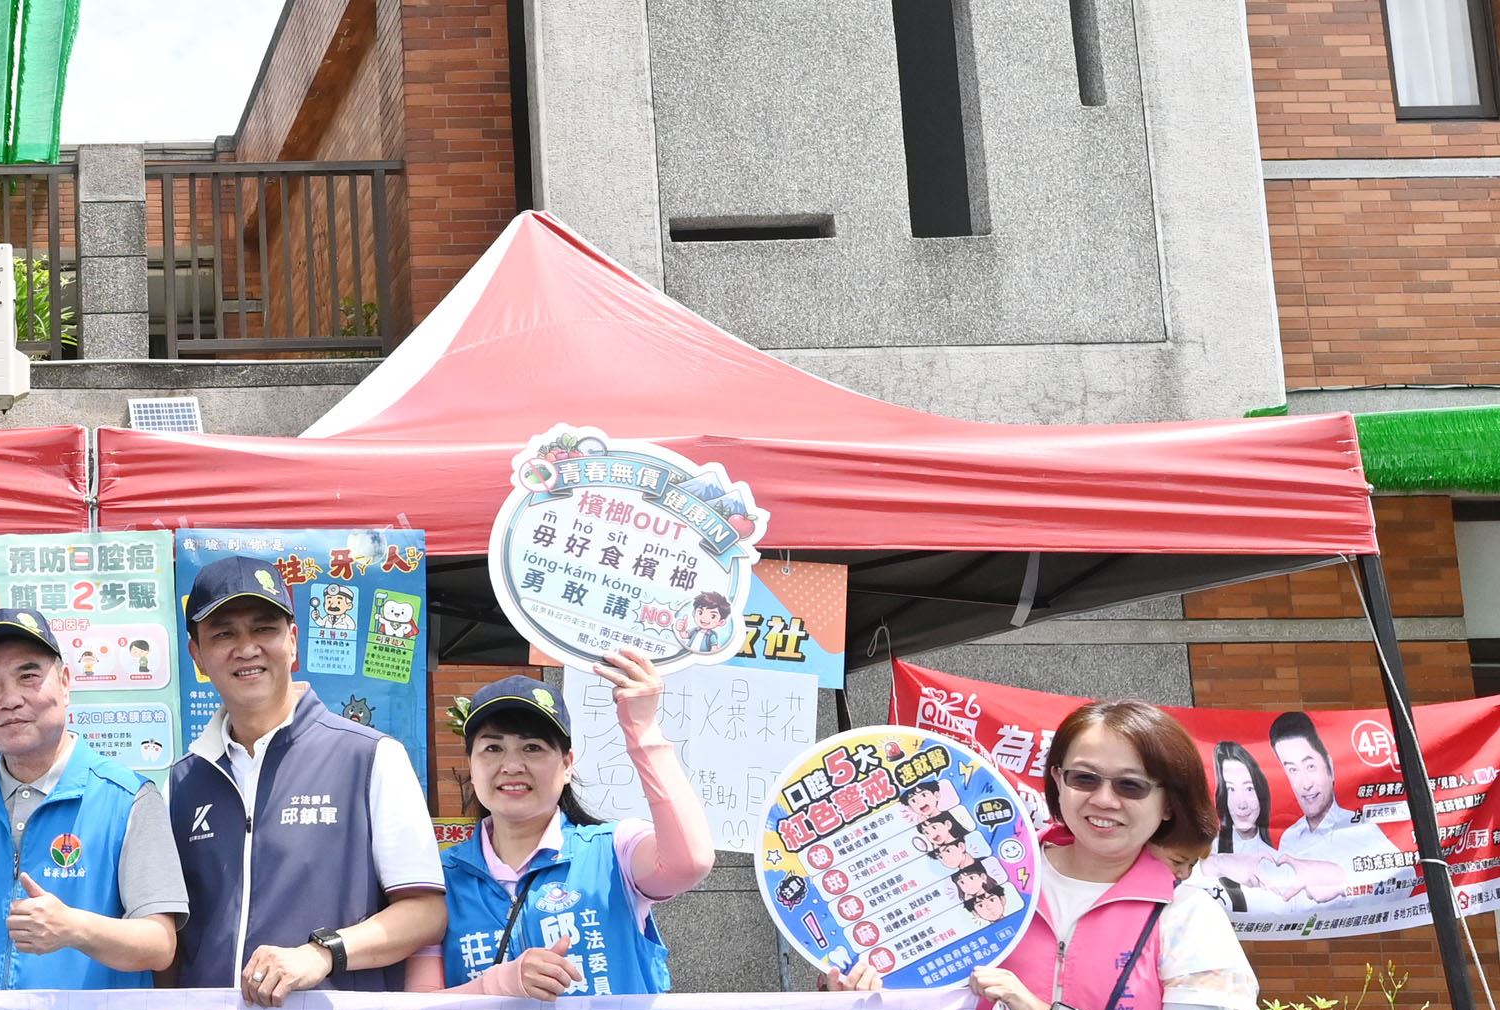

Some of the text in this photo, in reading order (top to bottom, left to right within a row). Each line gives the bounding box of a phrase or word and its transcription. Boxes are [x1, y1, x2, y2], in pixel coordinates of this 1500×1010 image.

[559, 462, 730, 543] 青春無價 健康IN
[577, 491, 688, 540] 檳榔OUT
[9, 543, 155, 575] 預防口腔癌
[10, 580, 159, 612] 簡單2步驟
[49, 619, 91, 632] 險因子
[640, 606, 674, 627] NO
[578, 632, 611, 651] 關心您
[599, 626, 667, 656] 南庄鄉衛生所
[1358, 731, 1391, 757] 4月
[784, 747, 881, 810] 口腔5大
[899, 747, 949, 784] 速就醫
[280, 806, 338, 825] 邱鎮軍
[291, 795, 331, 805] 立法委員
[778, 770, 896, 850] 紅色警戒
[580, 908, 613, 996] 立法委員
